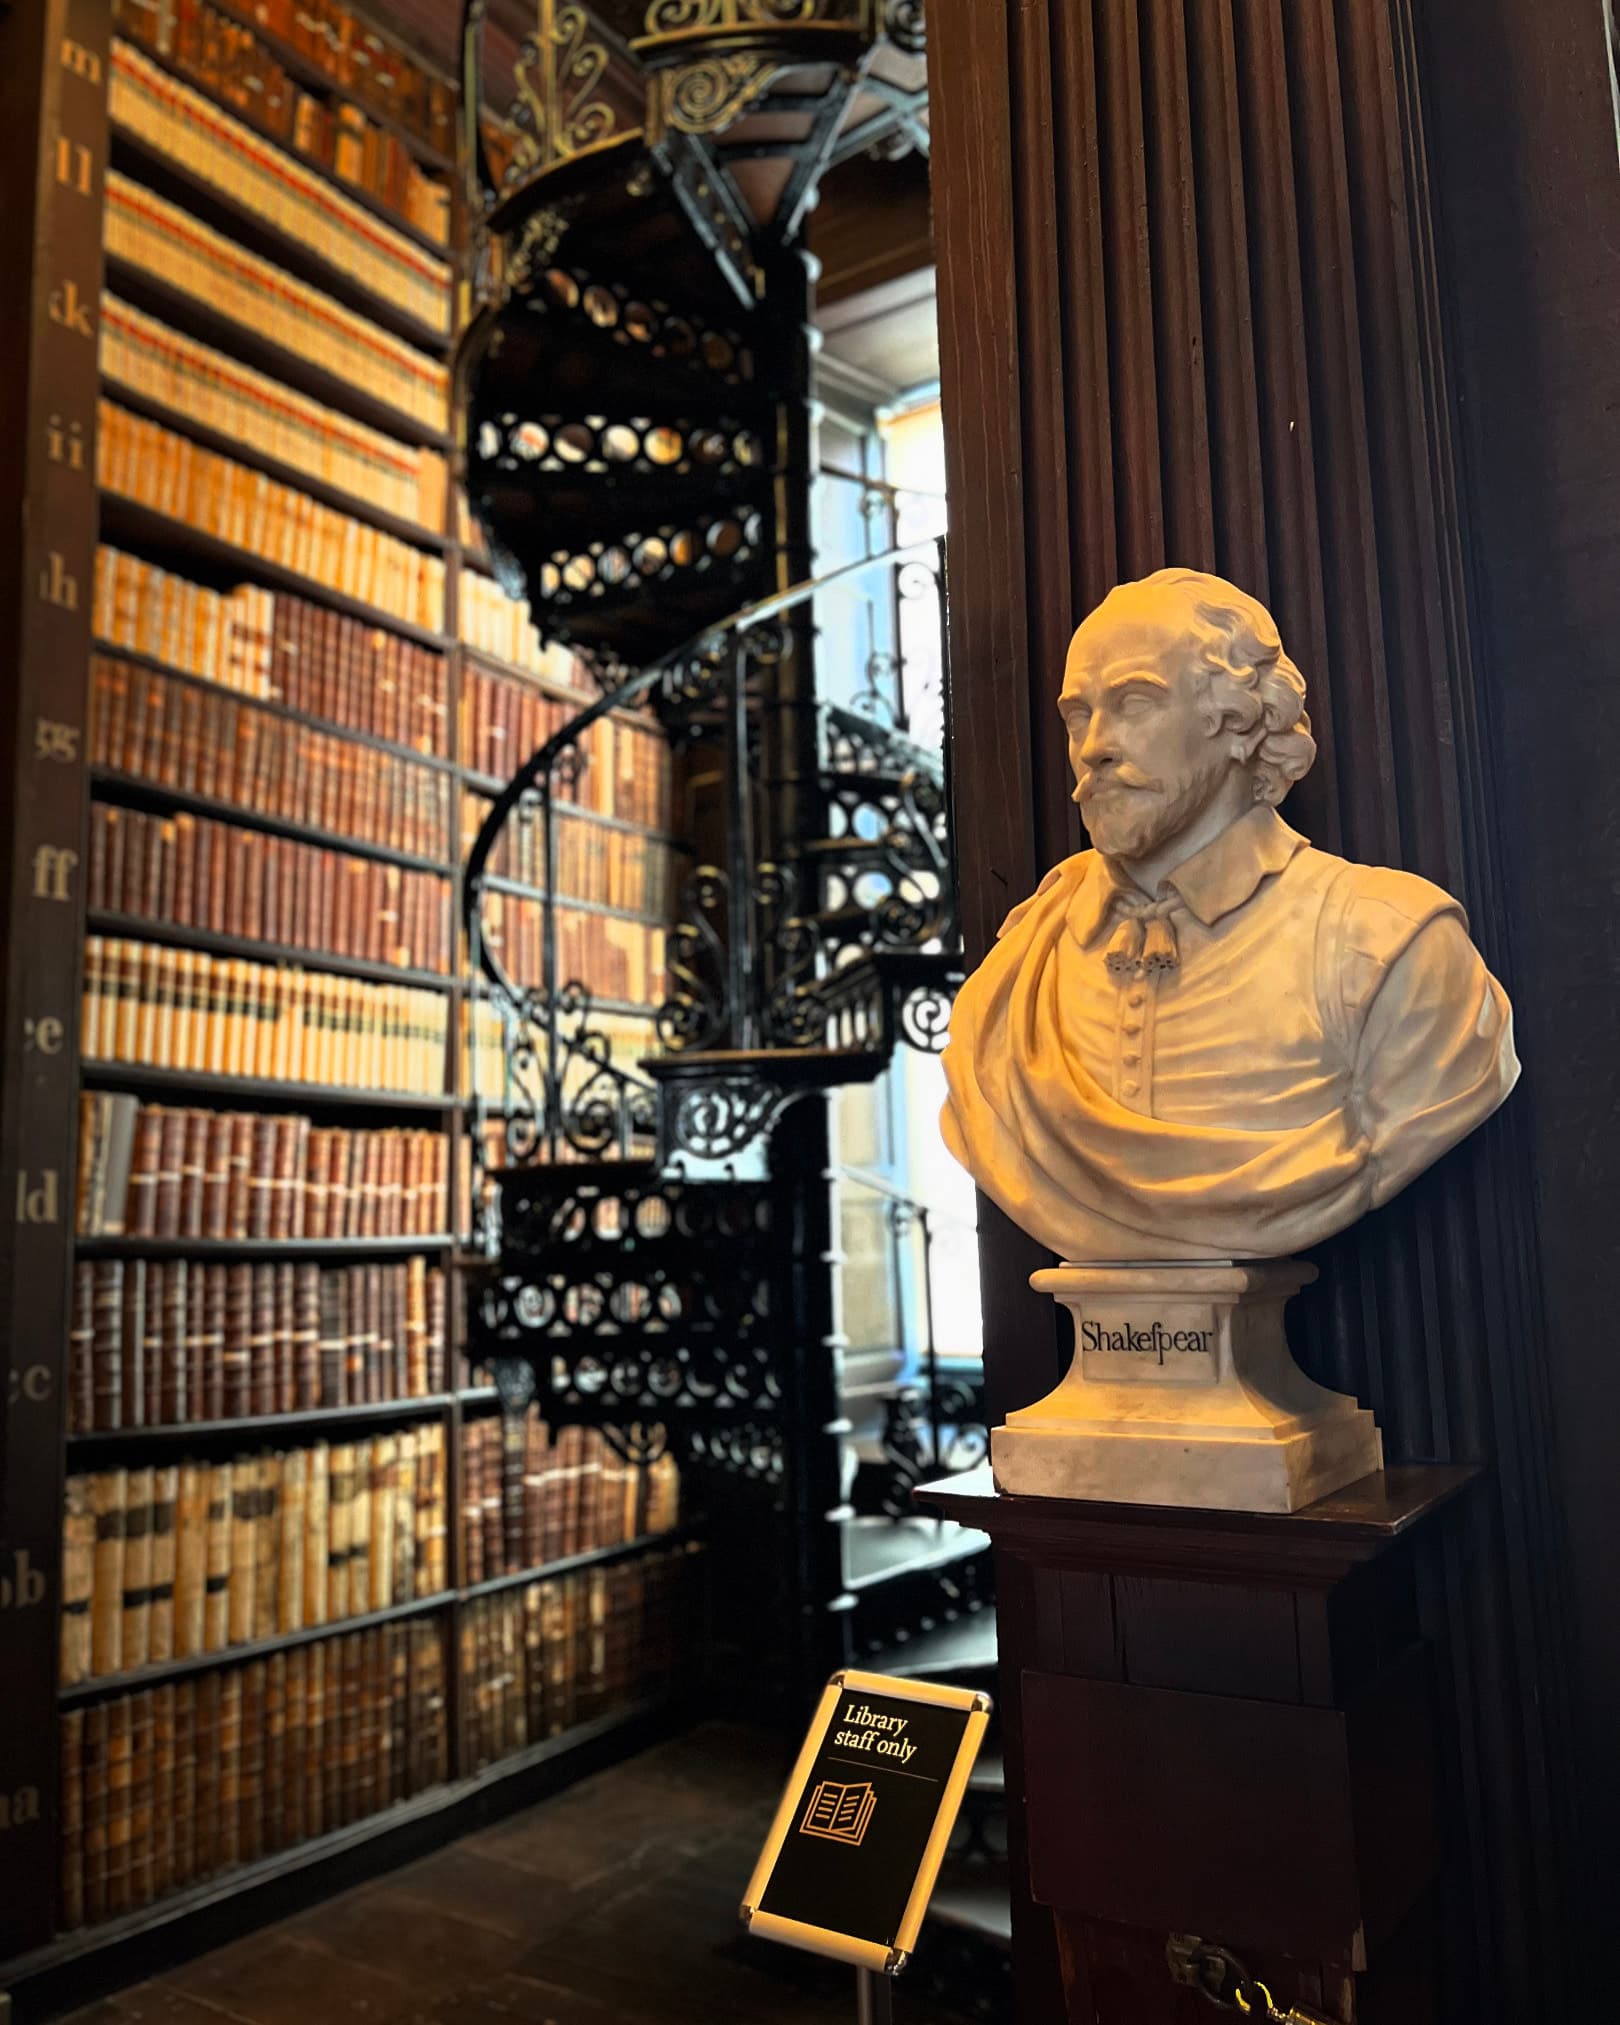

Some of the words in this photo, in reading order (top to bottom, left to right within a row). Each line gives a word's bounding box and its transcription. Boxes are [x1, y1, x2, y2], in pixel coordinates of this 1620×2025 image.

[33, 845, 78, 900] ff
[843, 1704, 908, 1737] Library
[834, 1730, 880, 1751] staff
[876, 1737, 917, 1764] only
